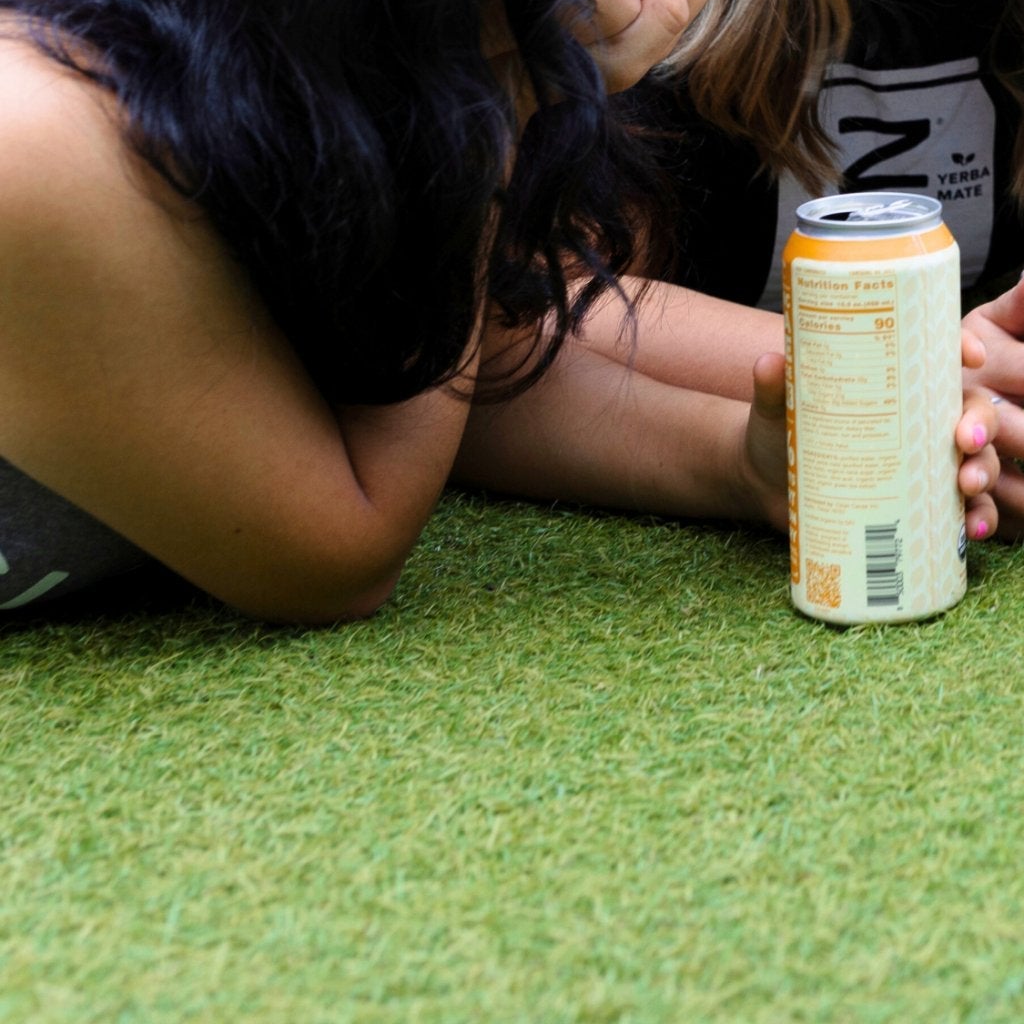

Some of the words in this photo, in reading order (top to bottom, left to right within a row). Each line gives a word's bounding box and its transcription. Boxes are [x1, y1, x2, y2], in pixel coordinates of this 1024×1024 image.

[938, 166, 990, 185] YERBA
[938, 184, 983, 201] MATE
[797, 277, 848, 290] Nutrition
[854, 280, 894, 290] Facts
[874, 317, 894, 329] 90
